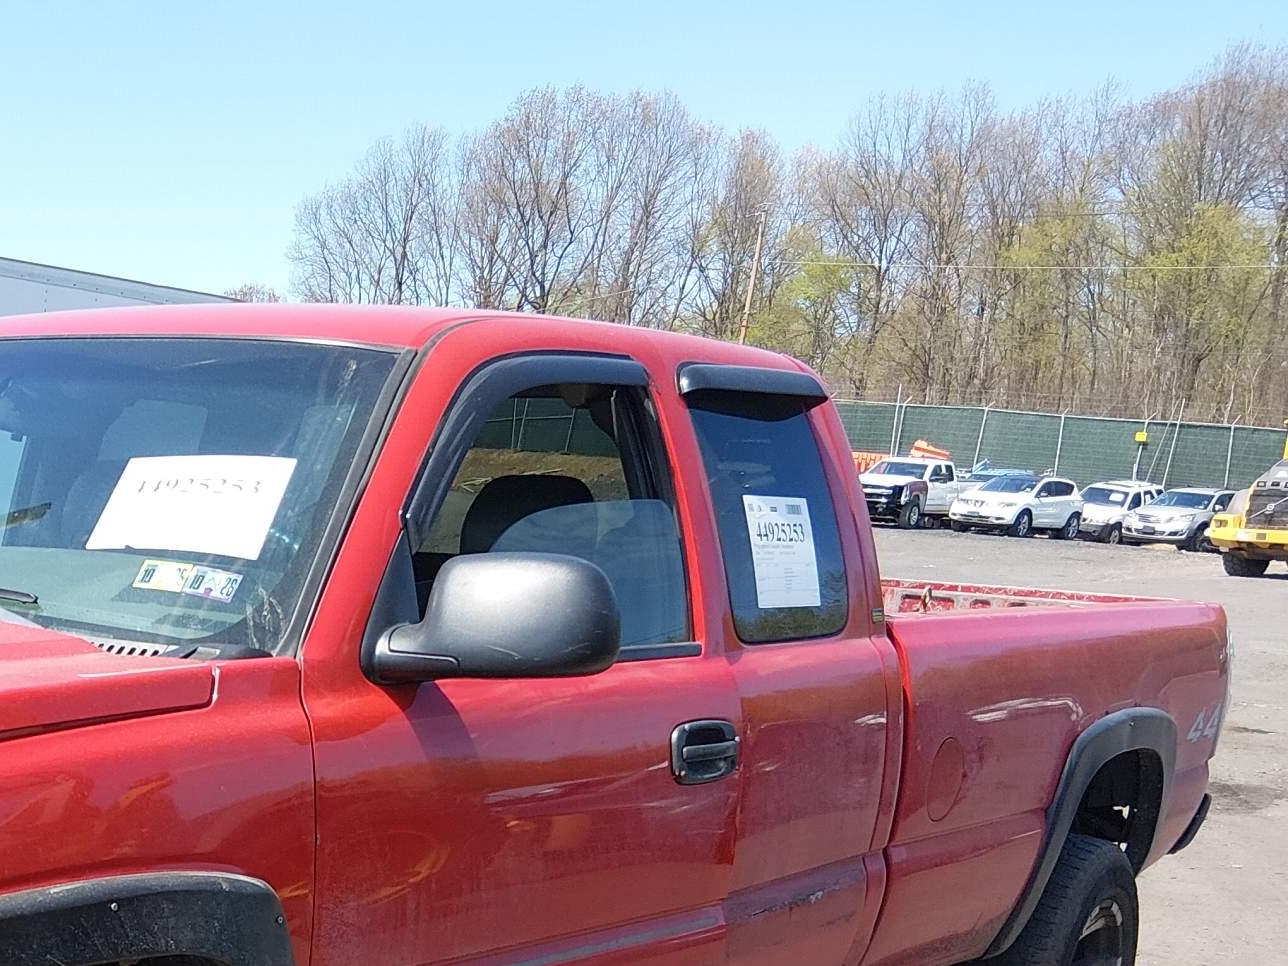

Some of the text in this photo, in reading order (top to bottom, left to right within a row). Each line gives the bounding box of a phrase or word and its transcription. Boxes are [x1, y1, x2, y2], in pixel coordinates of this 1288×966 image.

[756, 521, 806, 543] 44925253
[140, 567, 156, 583] 10
[189, 574, 238, 597] 10 26
